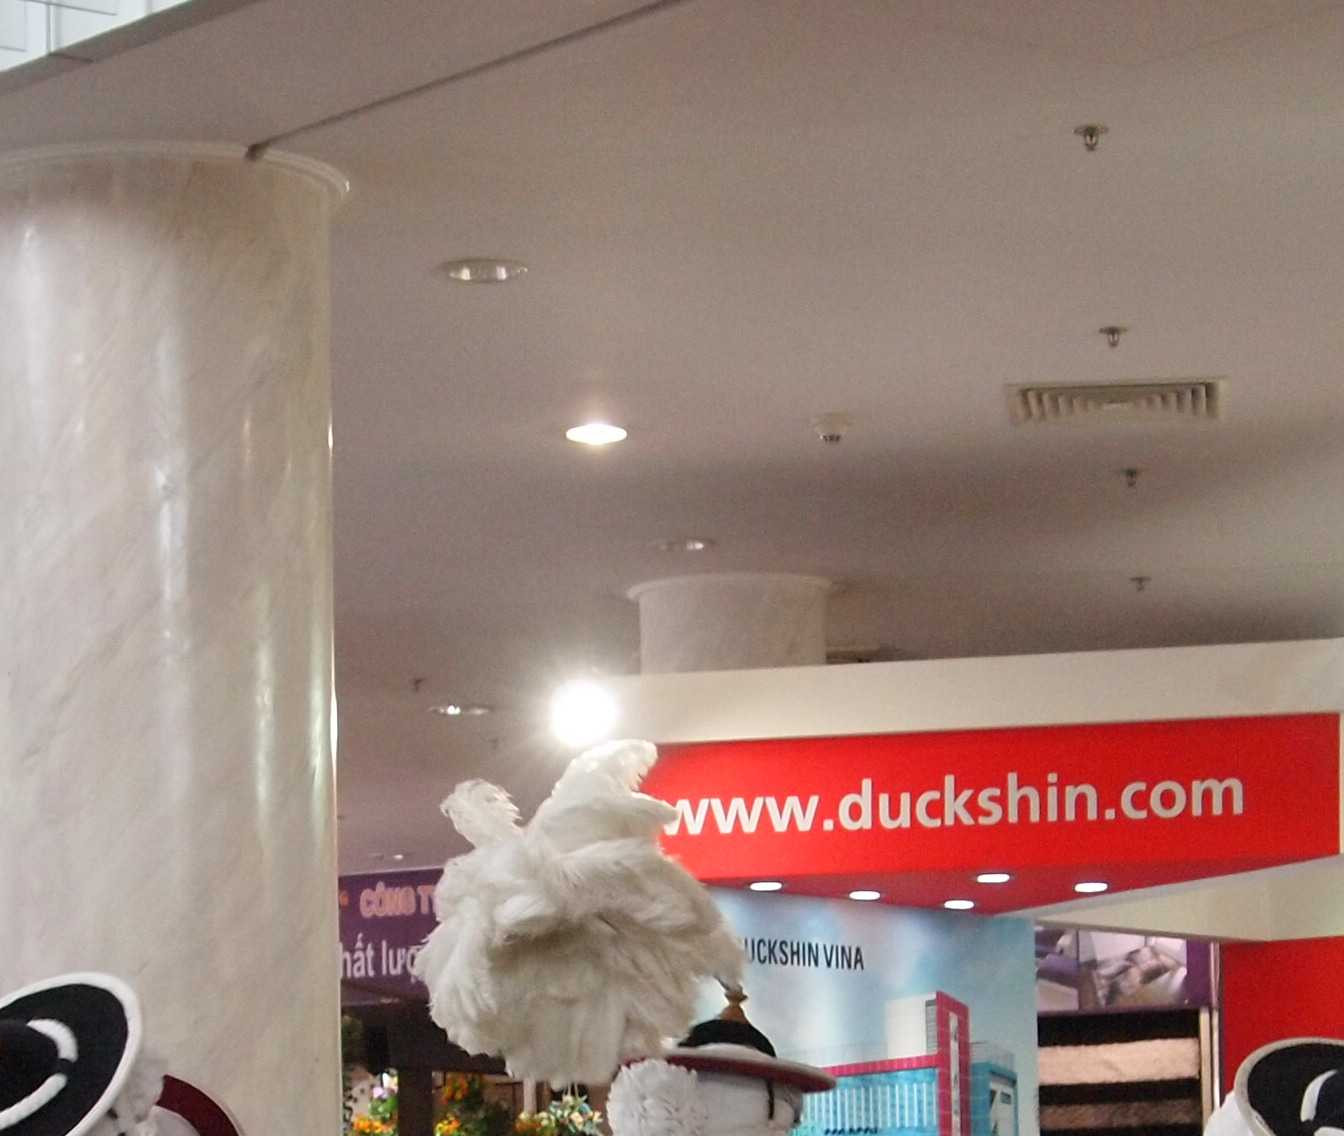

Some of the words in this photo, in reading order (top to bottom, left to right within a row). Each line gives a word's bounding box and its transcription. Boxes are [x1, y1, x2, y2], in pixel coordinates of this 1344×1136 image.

[662, 774, 1244, 836] www.duckshin.com
[416, 884, 438, 915] T
[338, 932, 375, 978] hất
[744, 936, 819, 968] UCKSHIN
[823, 943, 864, 971] VINA
